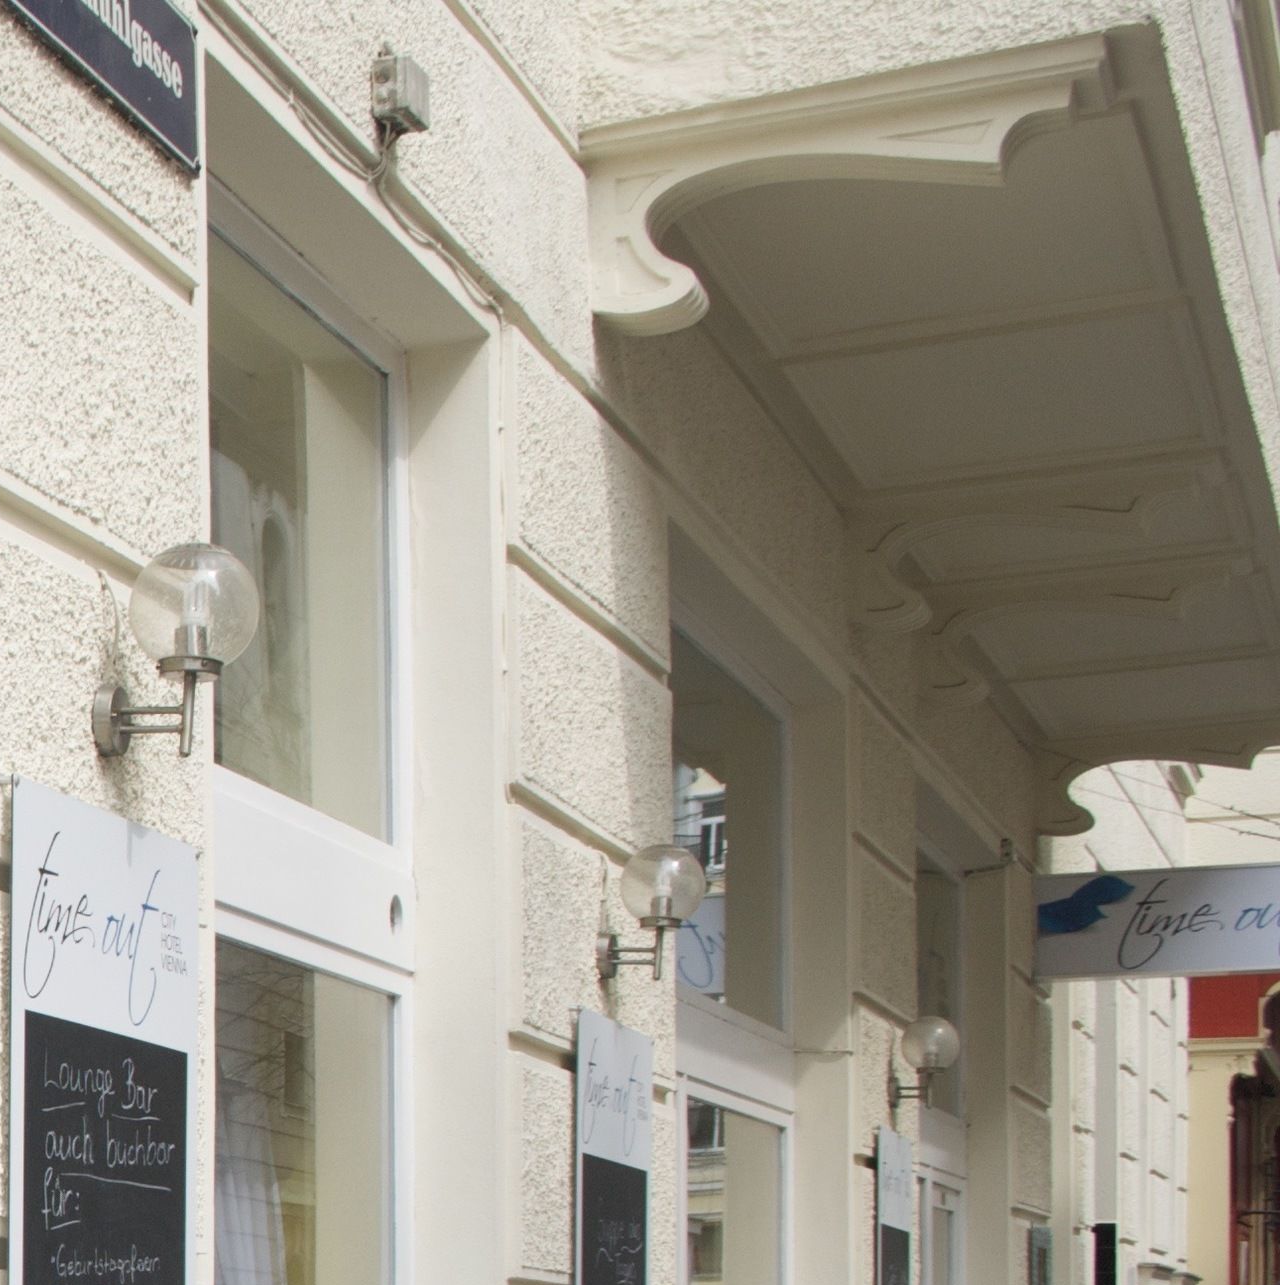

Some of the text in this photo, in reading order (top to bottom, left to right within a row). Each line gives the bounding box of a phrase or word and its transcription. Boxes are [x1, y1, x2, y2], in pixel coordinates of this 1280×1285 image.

[24, 831, 161, 1026] time out
[160, 933, 184, 954] HOTEL
[1117, 878, 1280, 970] time ou
[160, 953, 188, 977] VIENNA
[43, 1050, 158, 1118] Lounge Bar
[44, 1114, 95, 1165] auch
